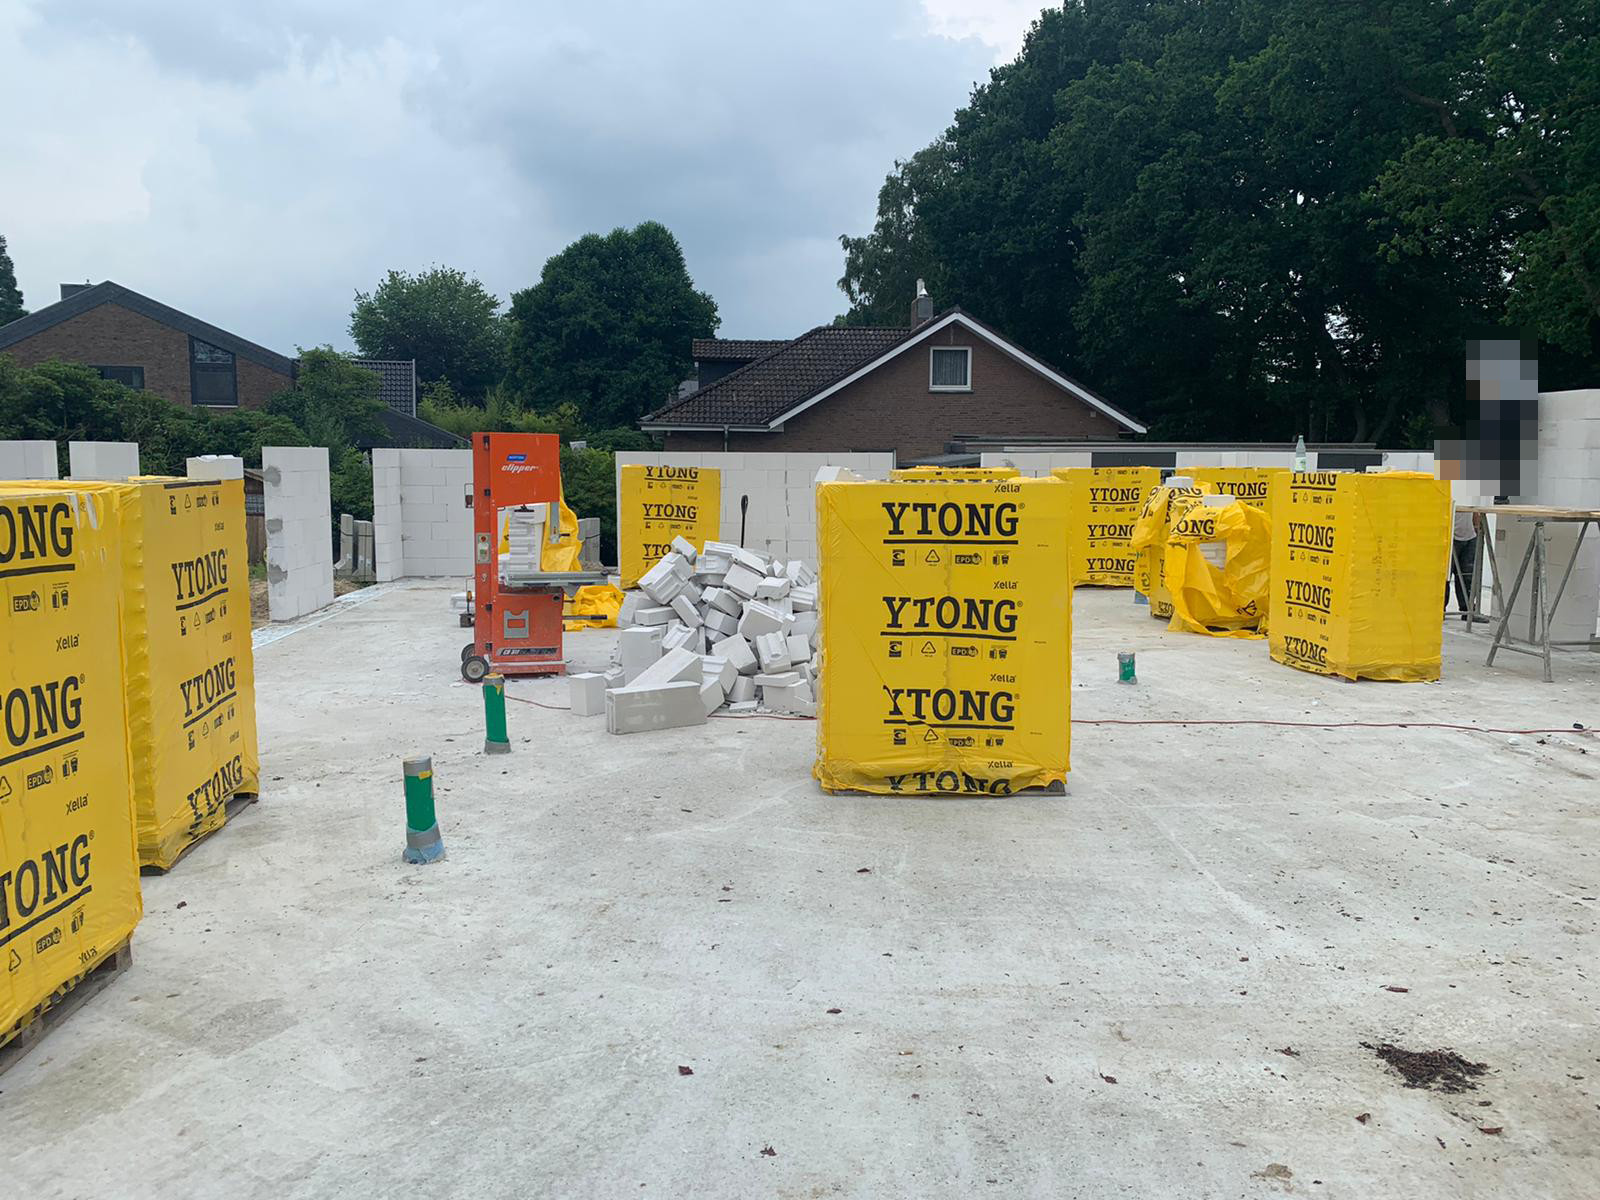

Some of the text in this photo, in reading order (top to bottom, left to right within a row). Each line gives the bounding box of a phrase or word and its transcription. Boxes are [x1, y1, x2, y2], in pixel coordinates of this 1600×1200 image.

[1090, 487, 1139, 501] YTONG
[1216, 482, 1267, 496] YTONG
[642, 503, 697, 519] YTONG
[882, 502, 1019, 536] YTONG
[1289, 522, 1334, 548] YTONG
[642, 543, 672, 557] YTO
[171, 549, 227, 600] YTONG
[1087, 558, 1135, 571] YTONG
[1286, 580, 1331, 608] YTONG
[882, 596, 1018, 633] YTONG
[180, 657, 235, 718] YTONG
[0, 676, 81, 747] ONG
[882, 684, 1015, 722] YTONG
